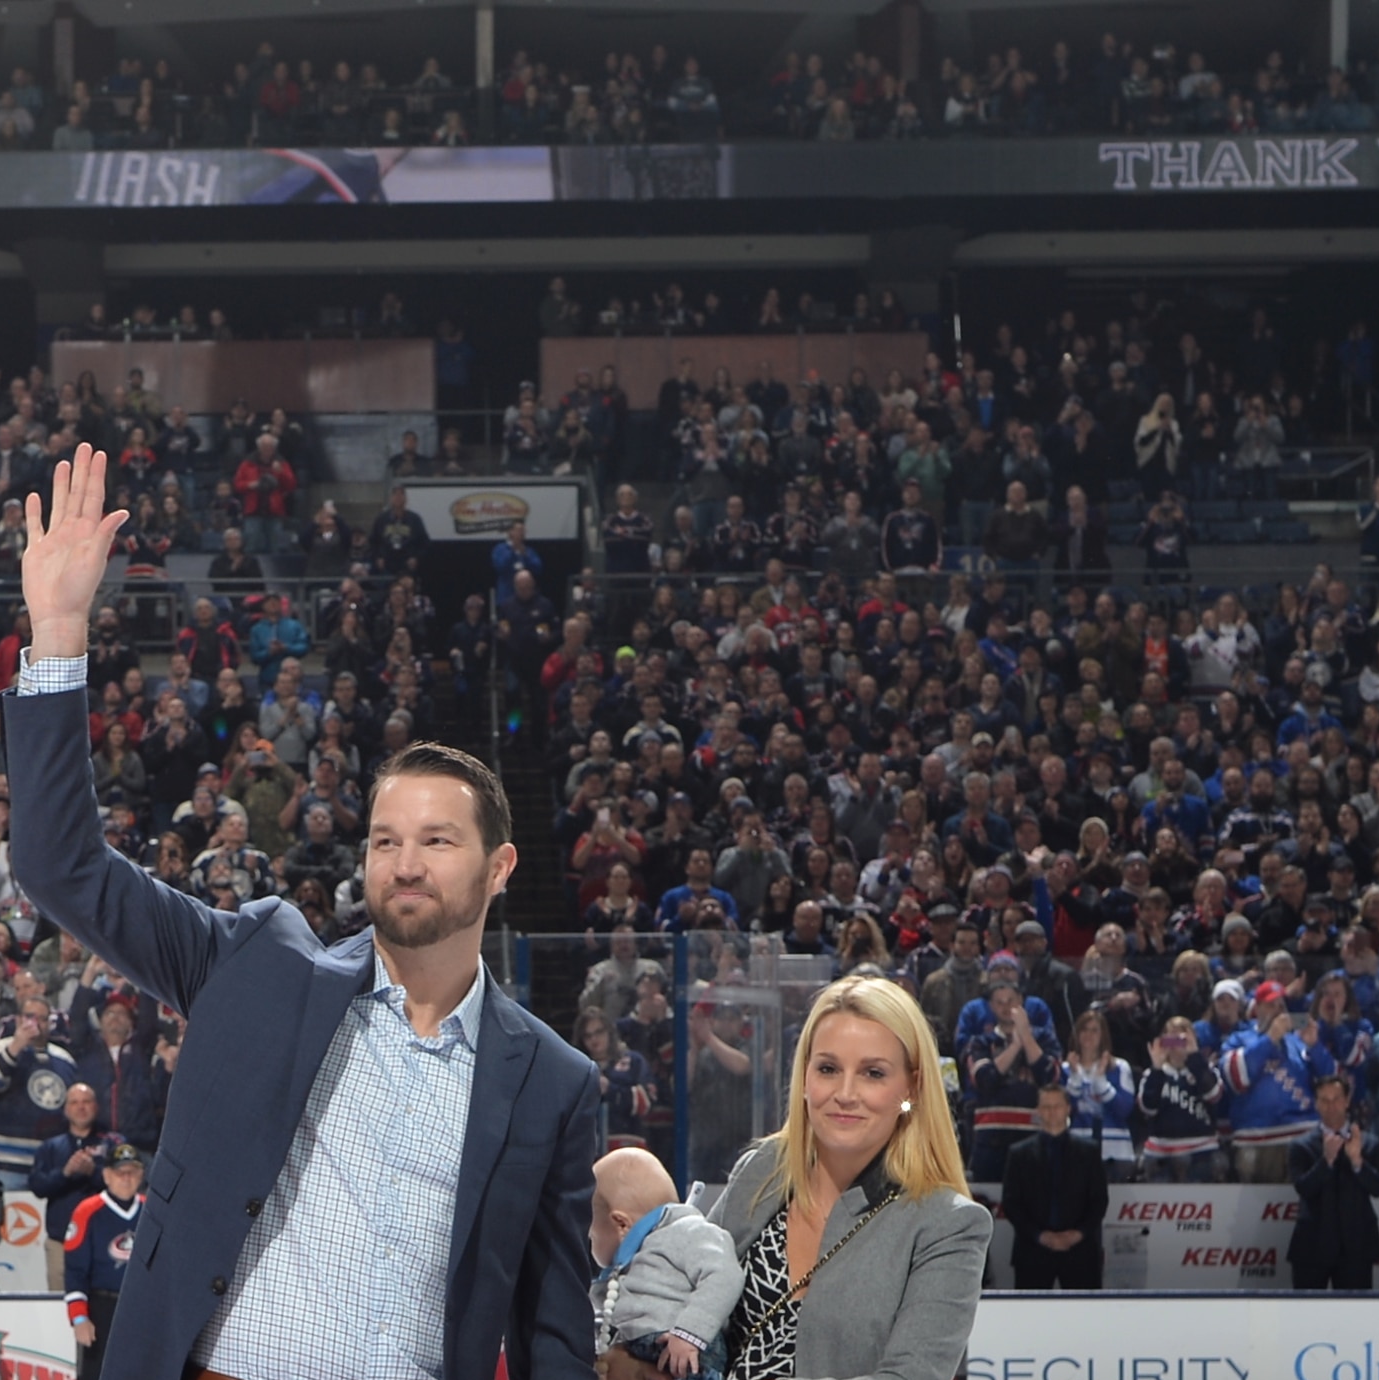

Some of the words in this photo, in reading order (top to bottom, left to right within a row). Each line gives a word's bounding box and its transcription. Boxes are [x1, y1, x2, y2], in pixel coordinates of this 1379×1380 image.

[1099, 138, 1359, 188] THANK
[1117, 1202, 1213, 1222] KENDA
[1181, 1247, 1277, 1266] KENDA
